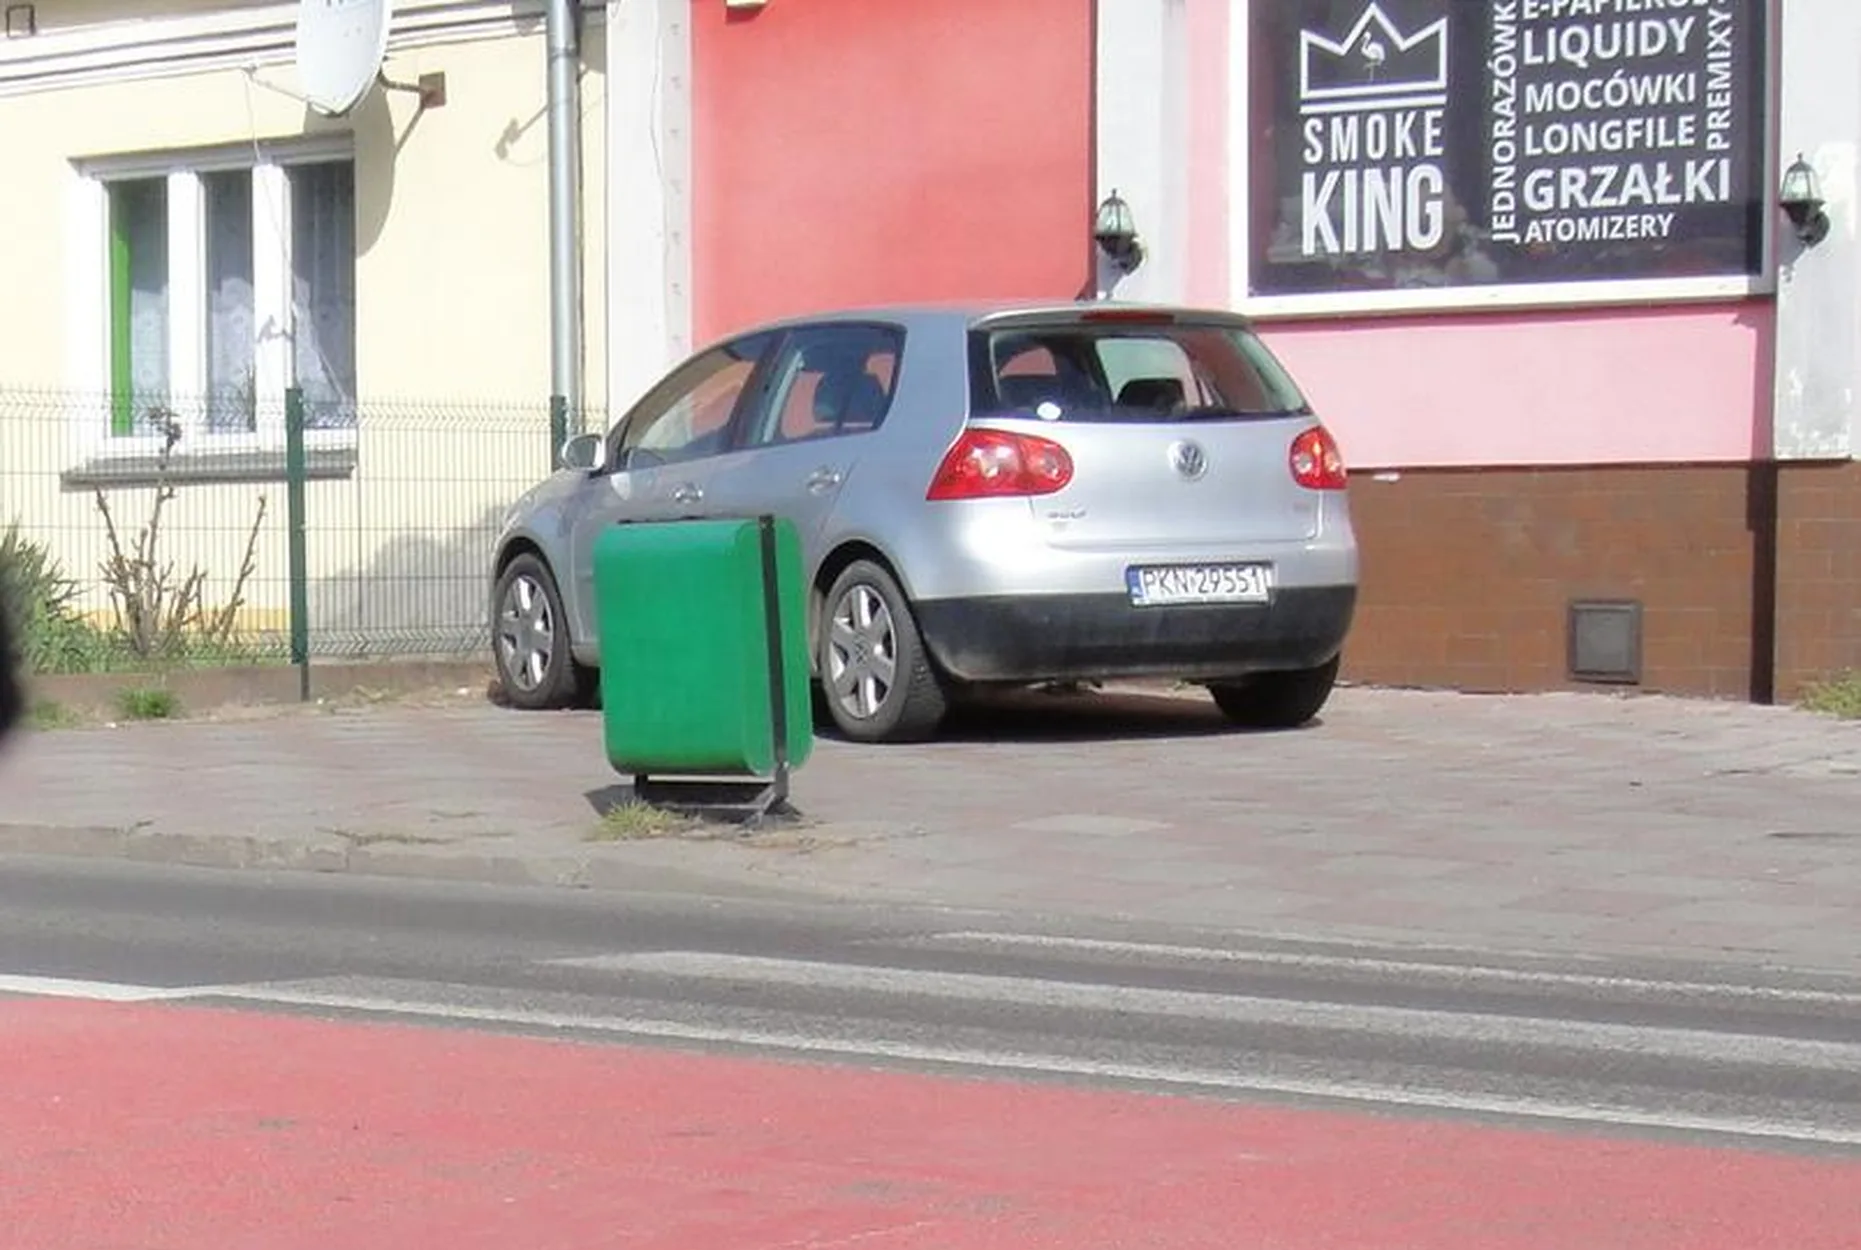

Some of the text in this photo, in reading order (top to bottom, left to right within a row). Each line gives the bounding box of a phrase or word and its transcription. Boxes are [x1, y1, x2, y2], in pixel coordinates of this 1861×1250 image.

[1523, 16, 1695, 68] LIQUIDY
[1525, 69, 1696, 113] MOCÓWKI
[1706, 8, 1732, 150] PREMIXY
[1303, 110, 1444, 164] SMOKE
[1524, 115, 1695, 155] LONGFILE
[1302, 163, 1443, 255] KING
[1523, 158, 1731, 211] GRZAŁKI
[1523, 213, 1675, 243] ATOMIZERY
[1143, 567, 1190, 595] PKN
